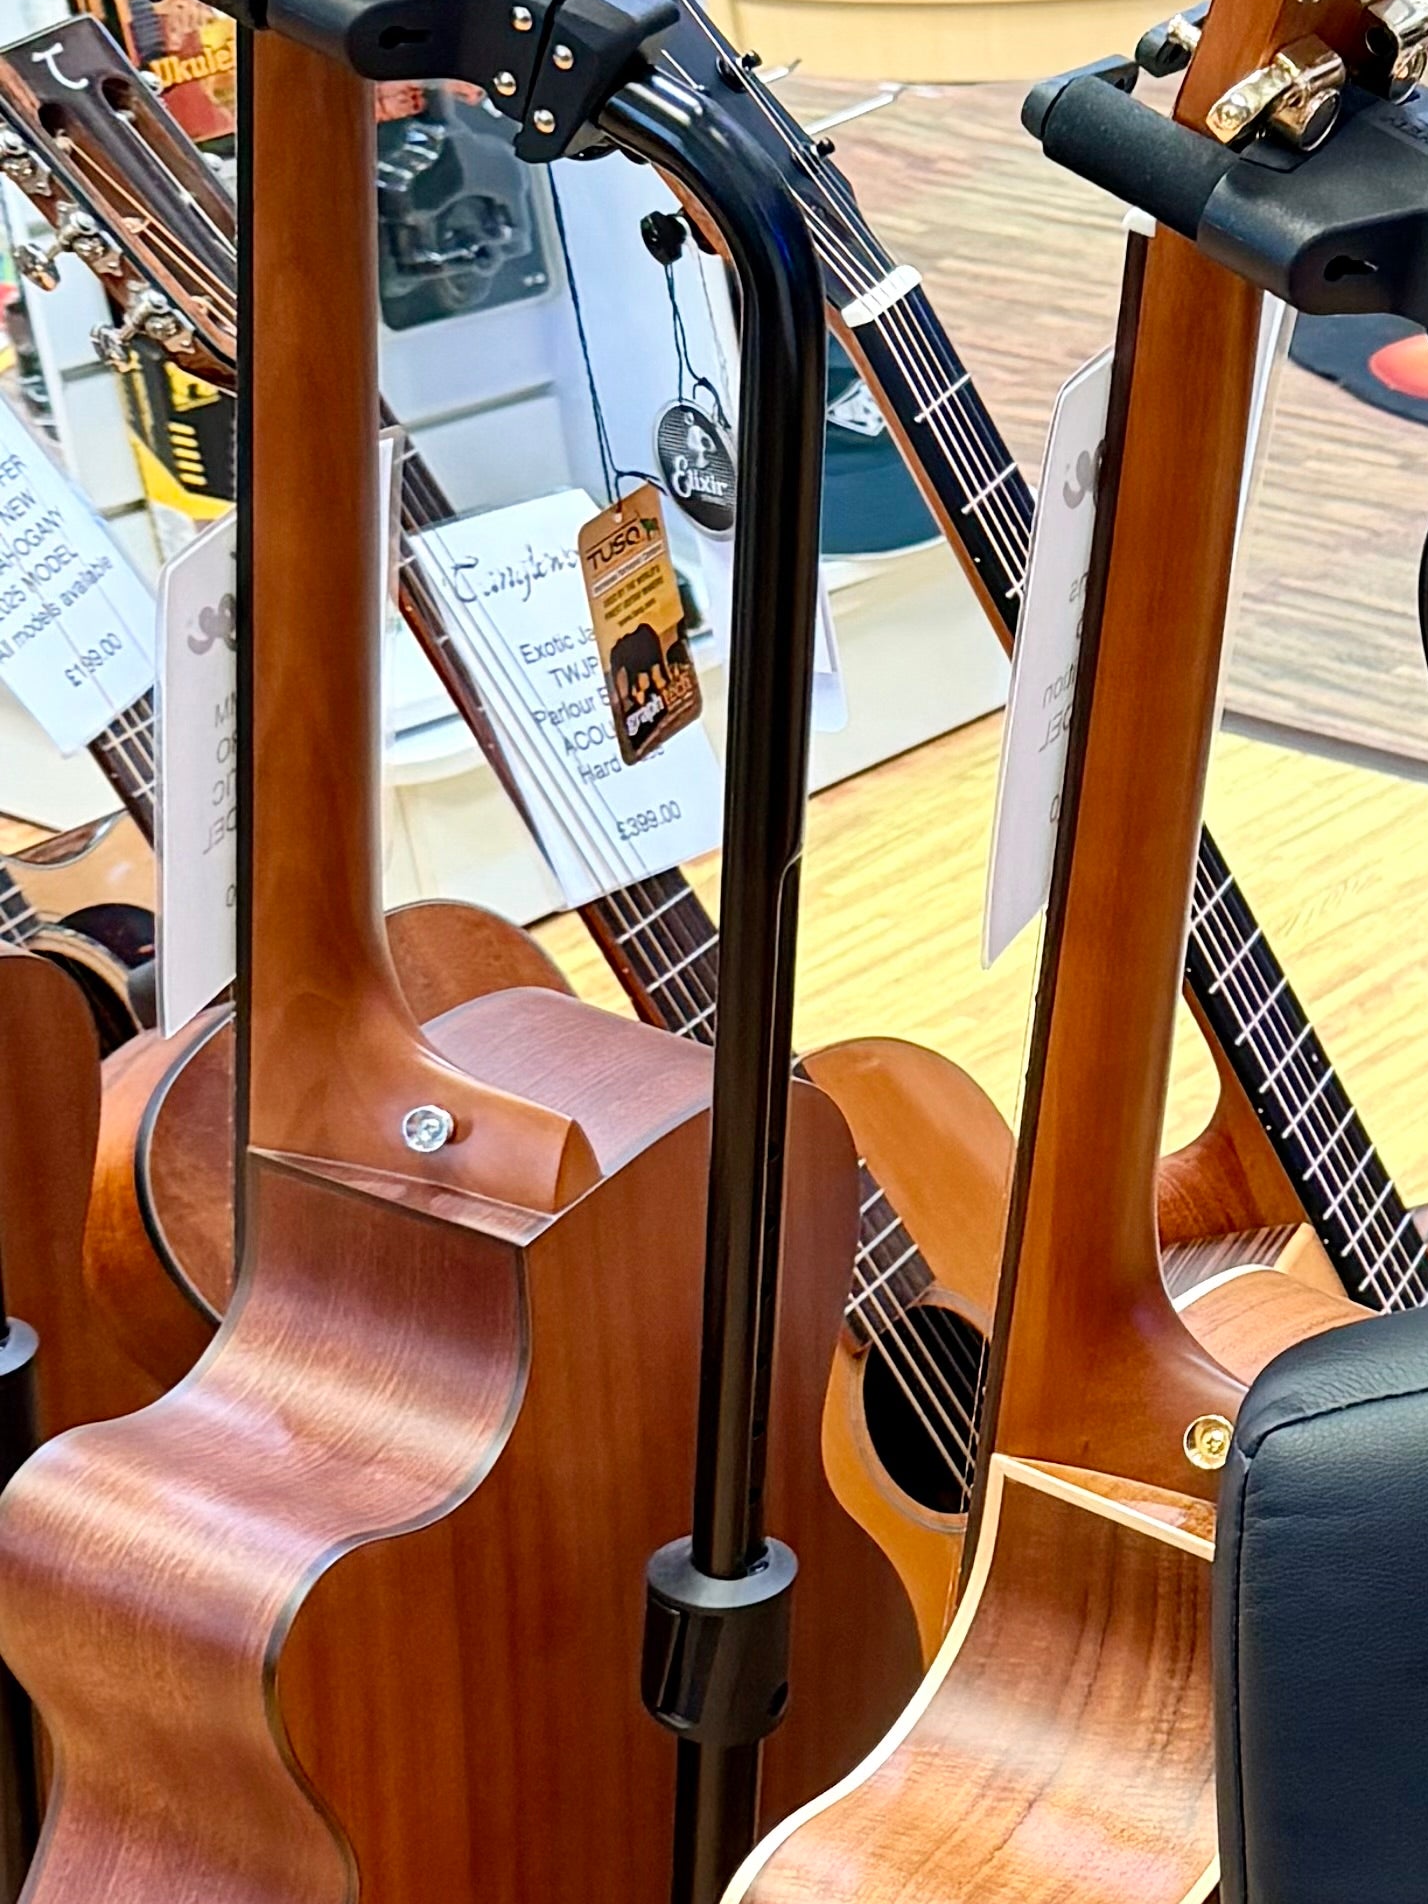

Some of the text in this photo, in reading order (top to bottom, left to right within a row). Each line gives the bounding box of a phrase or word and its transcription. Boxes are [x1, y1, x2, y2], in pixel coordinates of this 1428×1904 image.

[150, 39, 238, 89] Ukulel
[670, 454, 729, 498] Elixir
[0, 506, 66, 577] AHOGANY
[586, 525, 642, 572] TUSQ
[21, 544, 80, 588] MODEL
[518, 632, 575, 665] Exotic
[531, 696, 597, 727] Parlour
[564, 721, 617, 756] ACOU
[577, 754, 622, 785] Hard
[615, 799, 682, 841] £399.00
